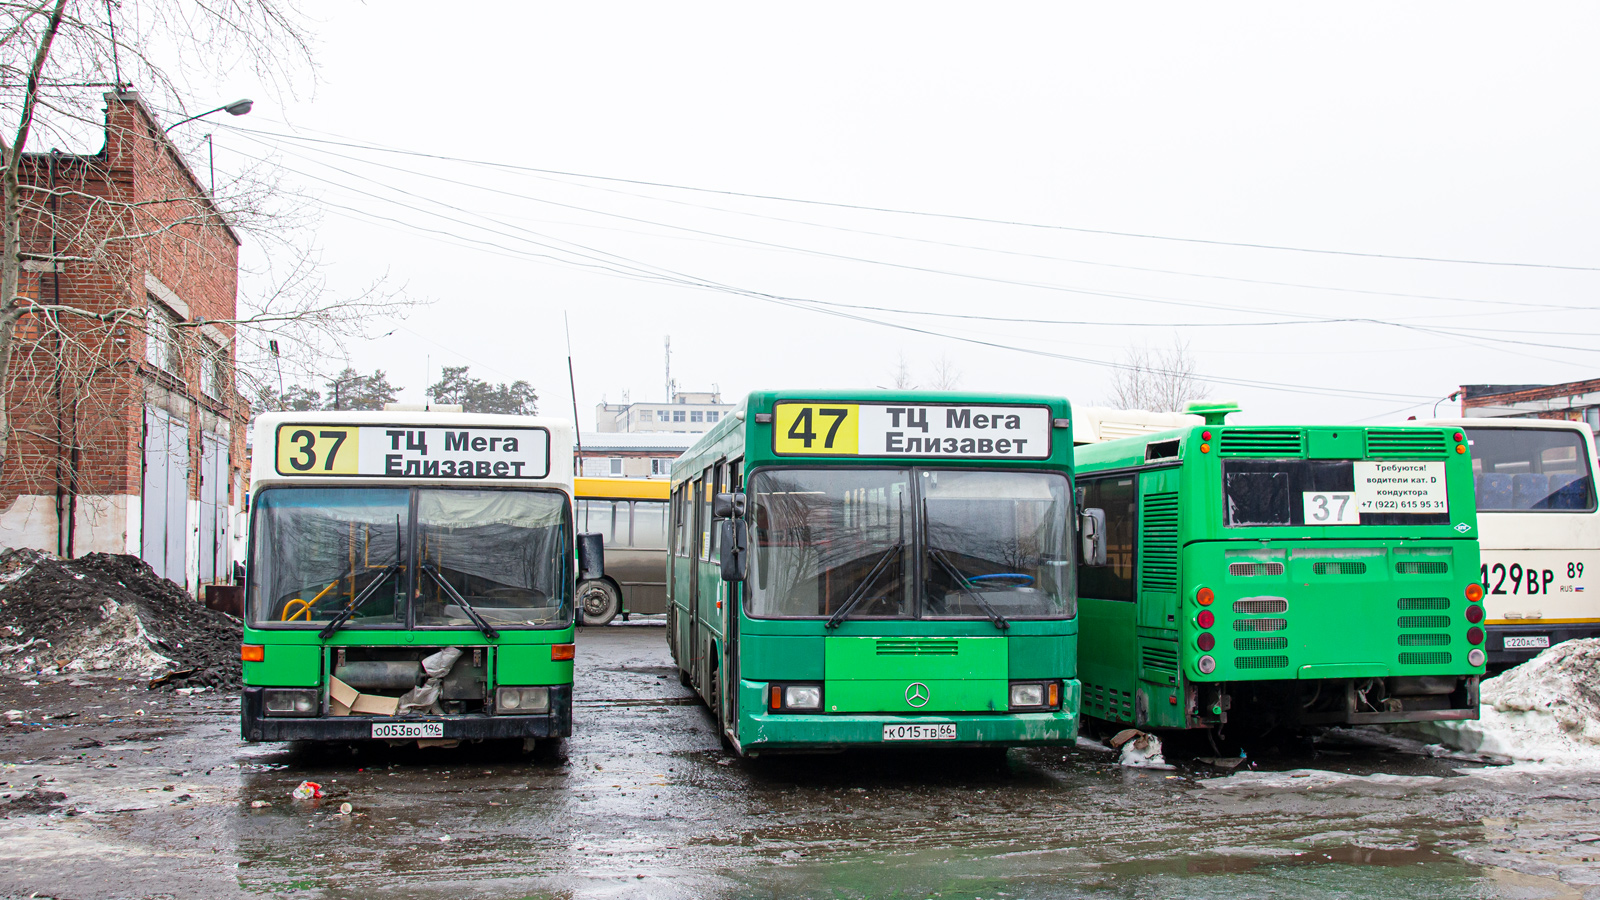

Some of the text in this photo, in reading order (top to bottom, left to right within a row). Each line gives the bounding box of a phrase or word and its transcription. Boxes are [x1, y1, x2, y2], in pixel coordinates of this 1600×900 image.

[787, 407, 848, 449] 47
[886, 407, 1021, 433] ТЦ Мега
[289, 429, 348, 471] 37
[385, 430, 519, 456] ТЦ Мега
[885, 432, 1028, 454] Елизавет
[385, 454, 526, 477] Елизавет
[1375, 464, 1427, 473] Требуются!
[1366, 477, 1409, 485] водители
[1430, 476, 1437, 484] D
[1376, 489, 1428, 497] кондуктора
[1312, 494, 1350, 522] 37
[1361, 500, 1444, 510] +7 (922) 615 95 31
[1567, 562, 1584, 578] 89
[374, 724, 440, 736] О053ВО 196
[889, 724, 952, 738] К015ТВ 66
